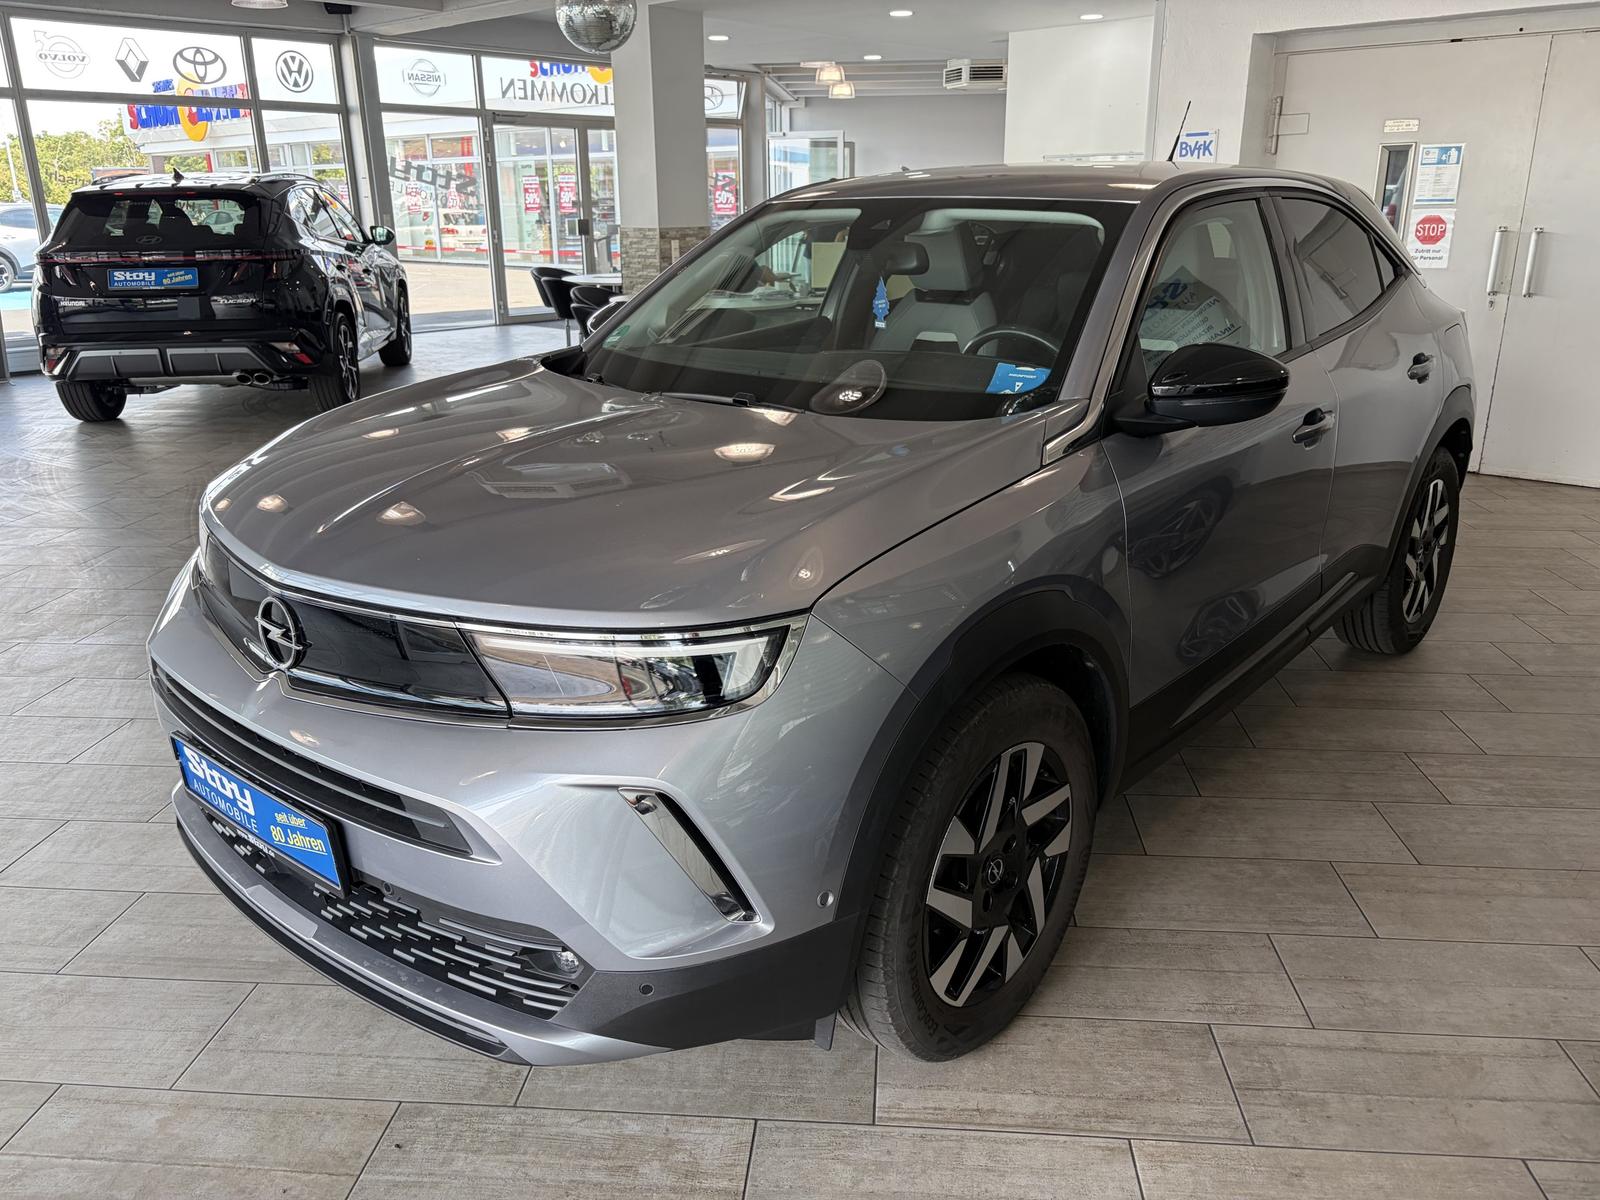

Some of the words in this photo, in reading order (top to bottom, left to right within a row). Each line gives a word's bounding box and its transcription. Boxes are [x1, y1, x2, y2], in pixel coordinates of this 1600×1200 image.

[1416, 224, 1446, 237] STOP
[113, 271, 156, 281] Stoy
[183, 745, 256, 817] Stoy
[193, 778, 259, 834] AUTOMOBILE
[274, 811, 289, 824] seit
[288, 813, 306, 828] über
[270, 825, 286, 843] 80
[286, 828, 327, 853] Jahren
